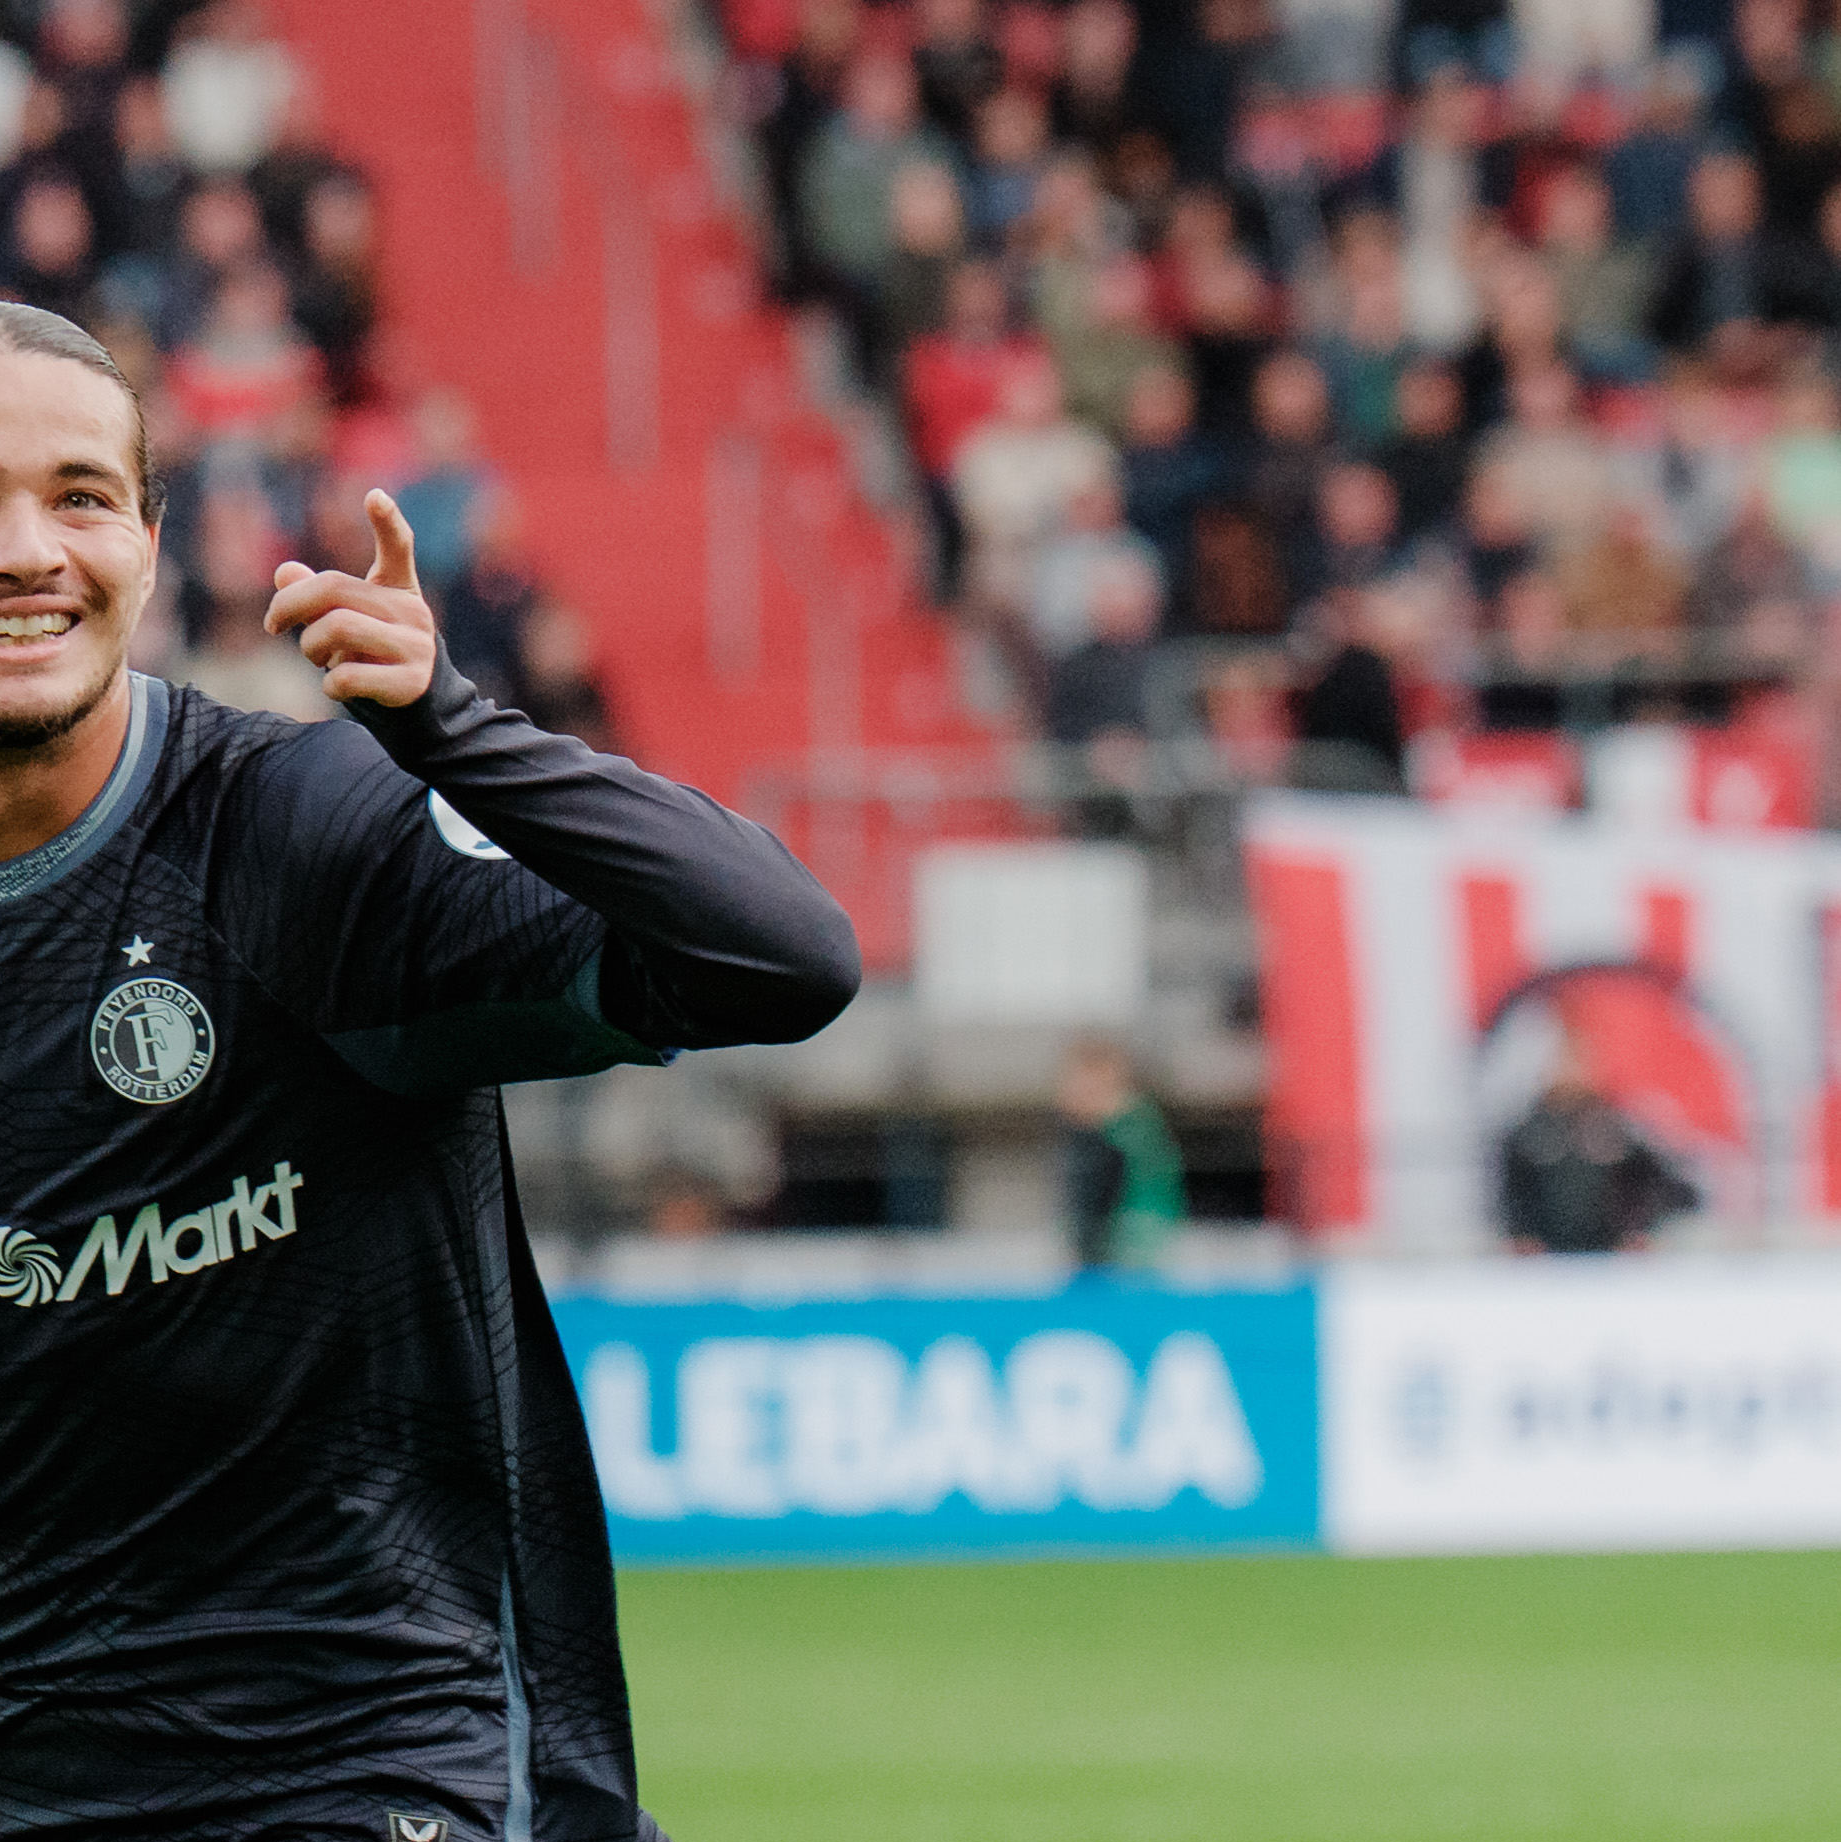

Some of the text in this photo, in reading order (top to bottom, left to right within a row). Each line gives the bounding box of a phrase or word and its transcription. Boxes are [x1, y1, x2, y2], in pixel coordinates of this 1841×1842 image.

[97, 983, 200, 1032] FEYENOORD
[106, 1048, 209, 1099] ROTTERDAM
[55, 1160, 304, 1302] Markt
[582, 1330, 1265, 1521] LEBARA
